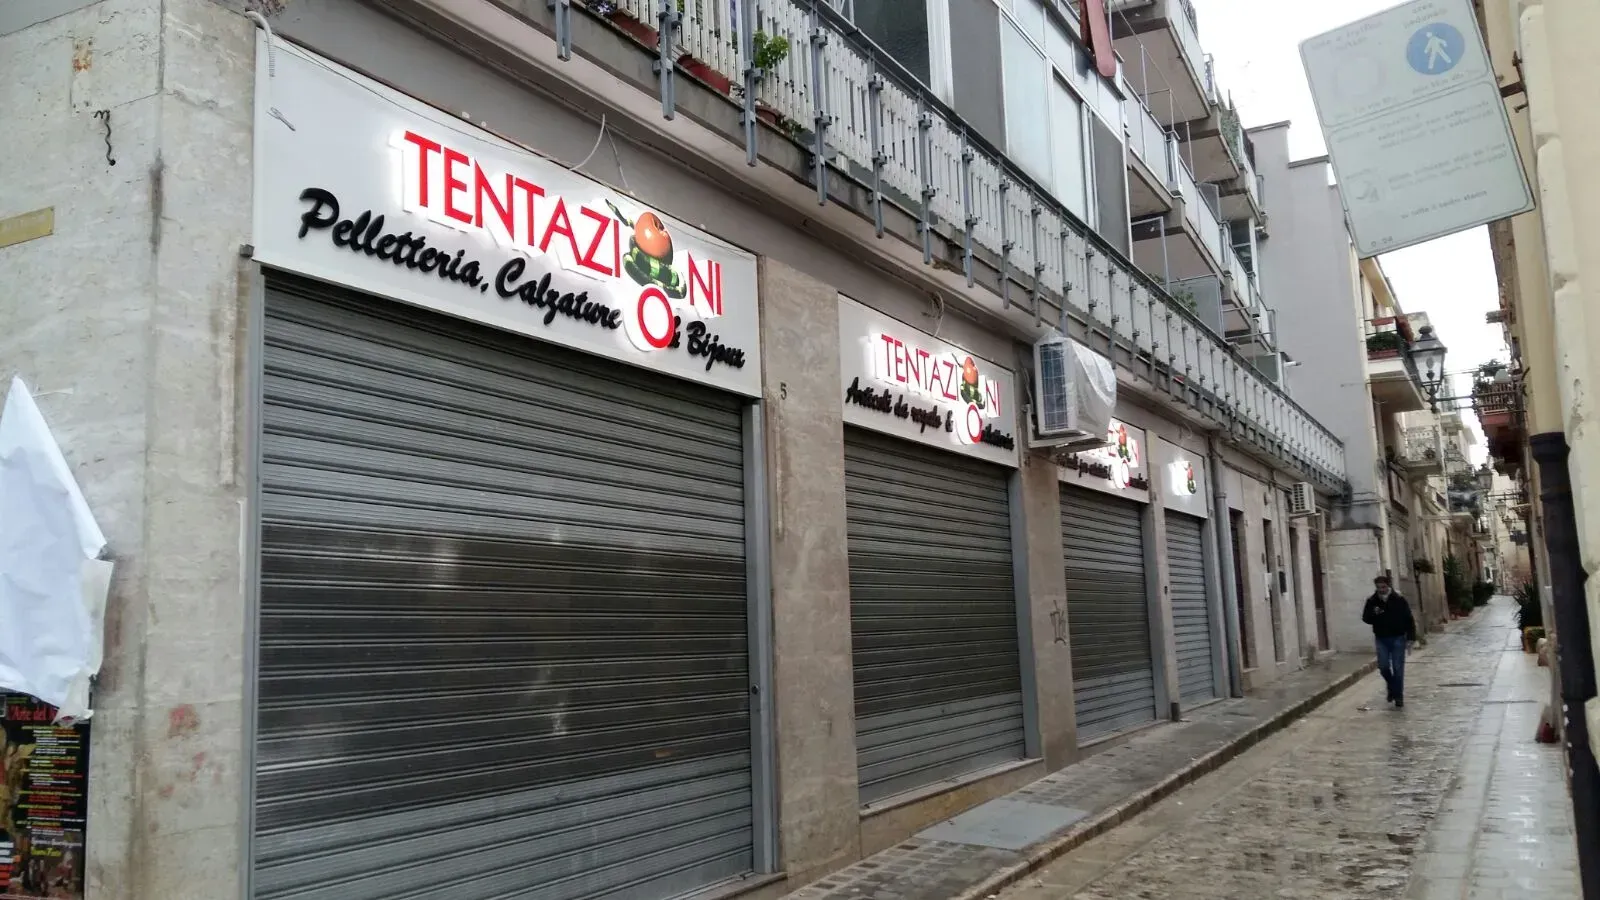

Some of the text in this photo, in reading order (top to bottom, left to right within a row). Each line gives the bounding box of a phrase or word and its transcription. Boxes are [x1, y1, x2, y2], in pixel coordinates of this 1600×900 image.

[299, 187, 489, 294] Pelletteria,
[495, 257, 622, 329] Calzature
[686, 320, 745, 371] Bijoux
[780, 381, 788, 401] 5
